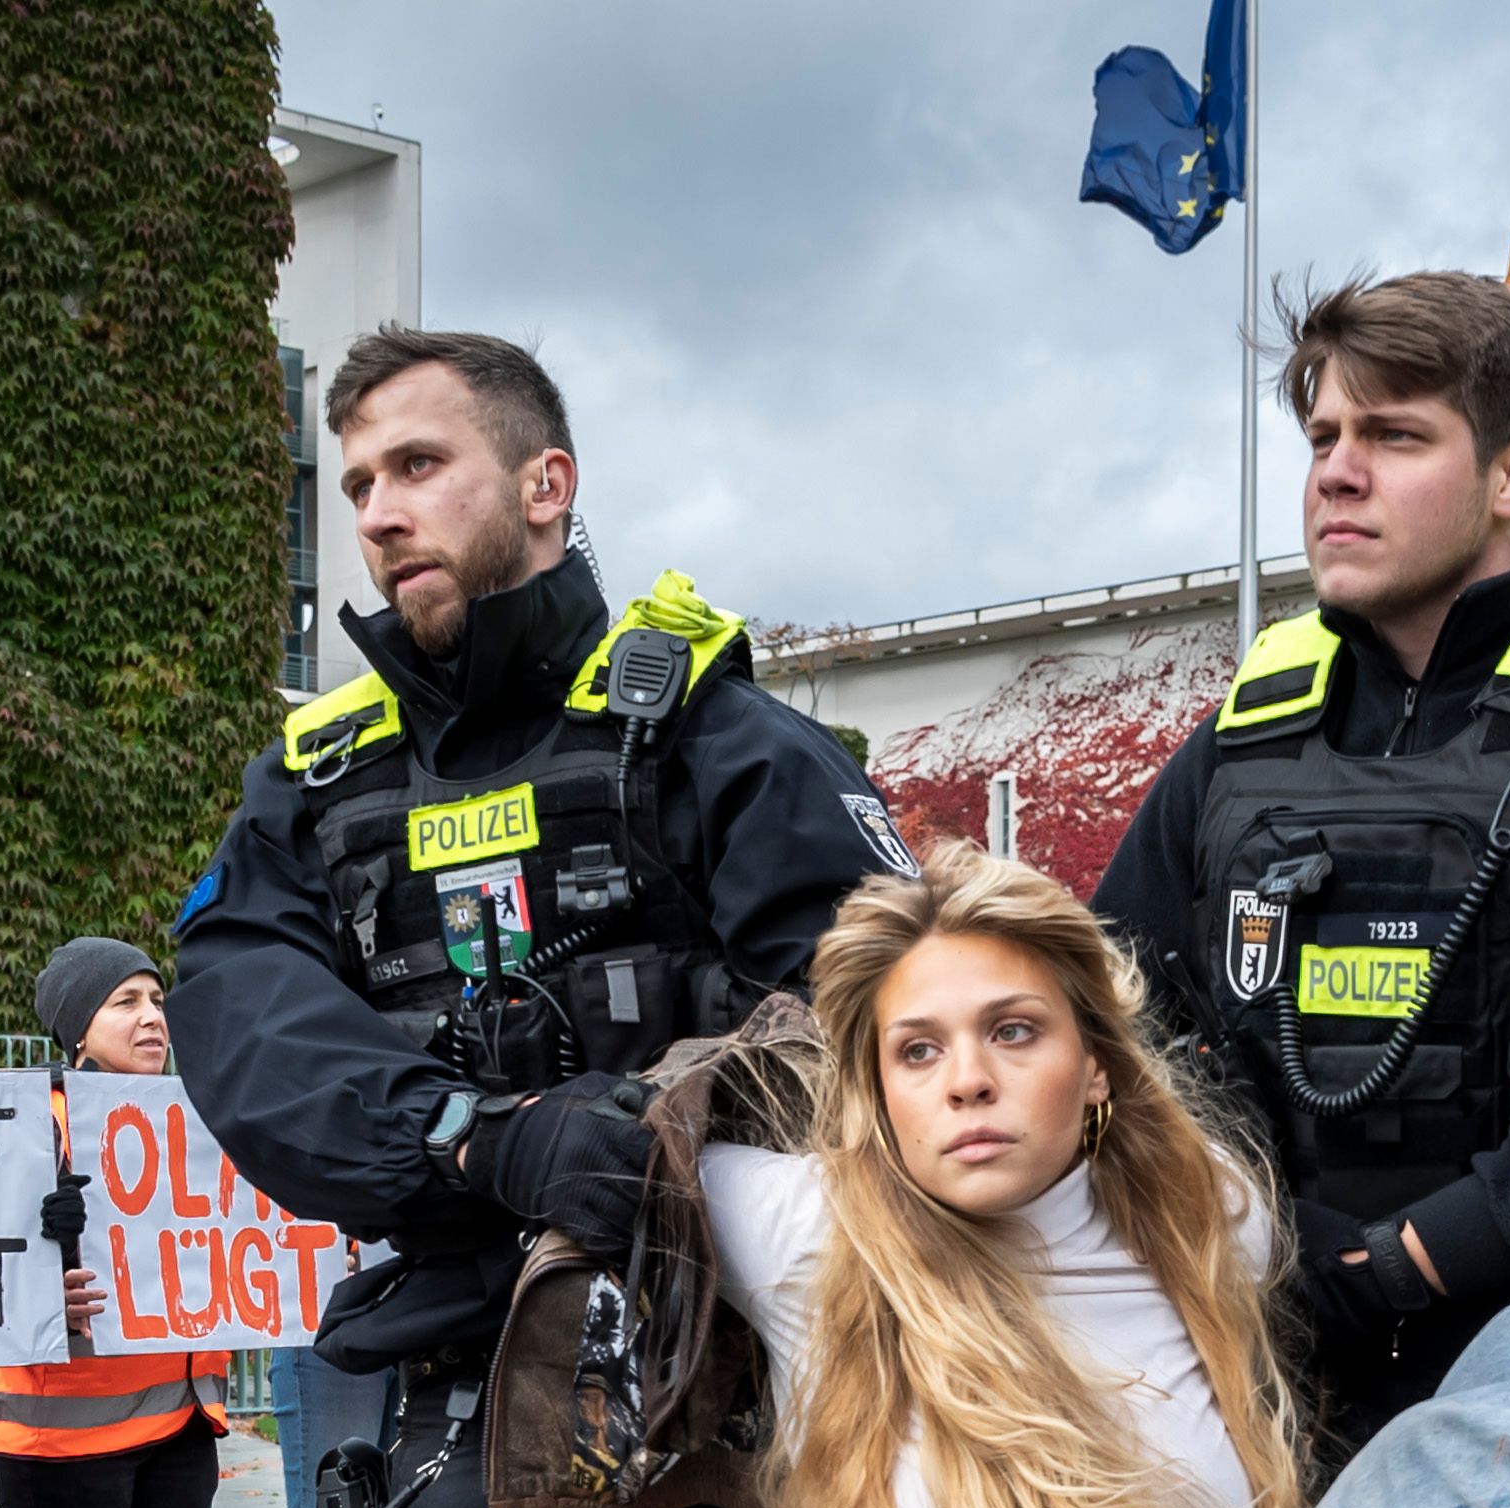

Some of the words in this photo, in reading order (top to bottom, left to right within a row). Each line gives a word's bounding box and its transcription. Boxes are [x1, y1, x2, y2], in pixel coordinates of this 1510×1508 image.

[419, 798, 529, 857] POLIZEI
[1235, 896, 1282, 917] POLIZEI
[1368, 921, 1419, 940] 79223
[371, 958, 410, 982] 61961
[1309, 959, 1421, 1002] POLIZEI
[107, 1224, 338, 1340] LÜGT
